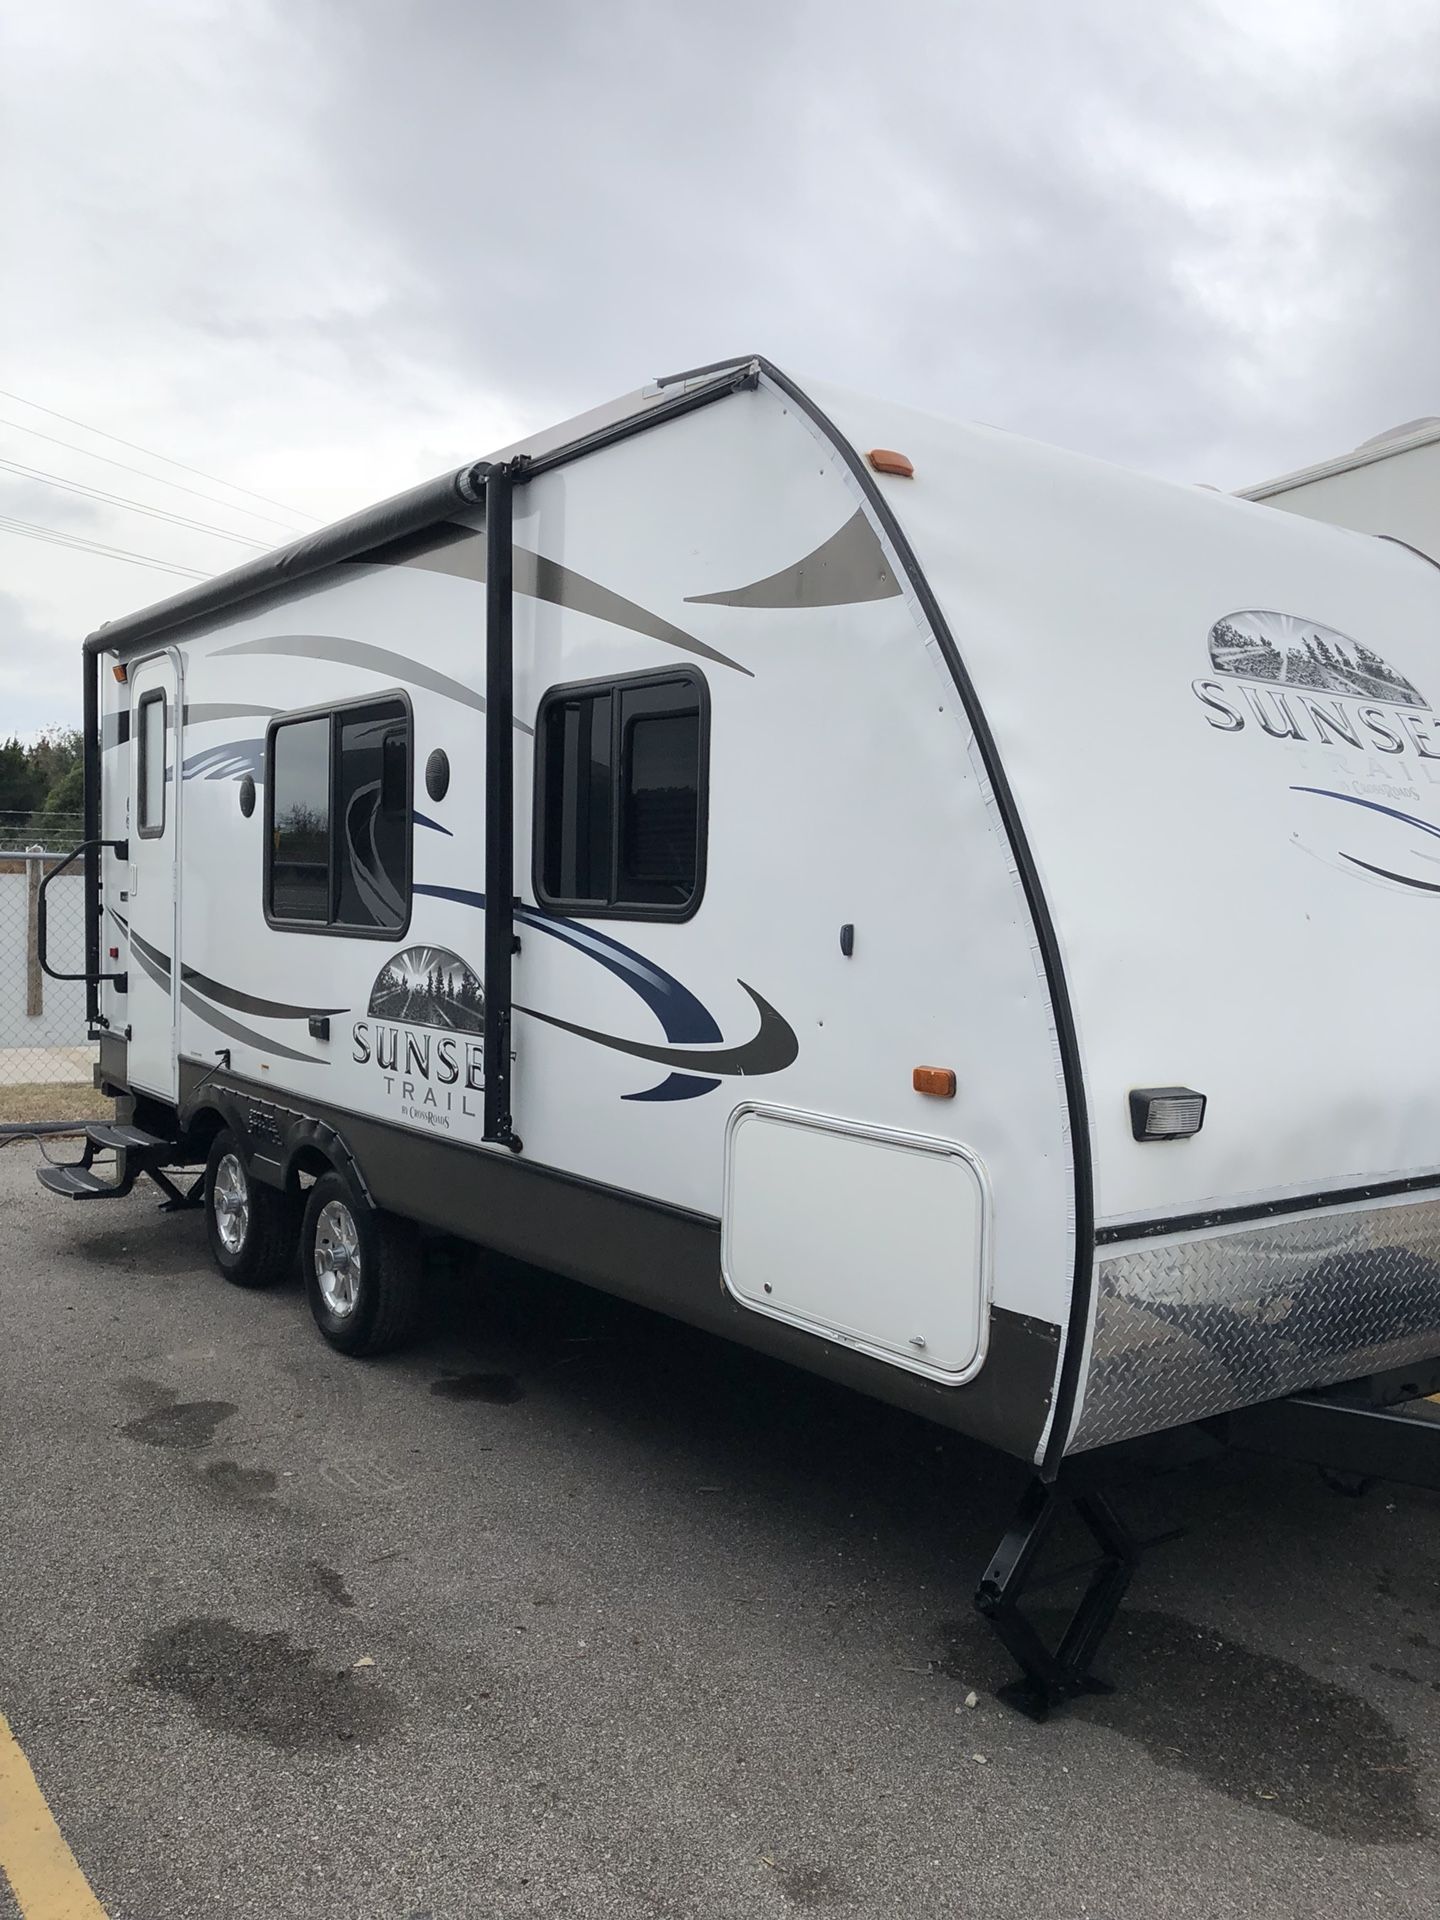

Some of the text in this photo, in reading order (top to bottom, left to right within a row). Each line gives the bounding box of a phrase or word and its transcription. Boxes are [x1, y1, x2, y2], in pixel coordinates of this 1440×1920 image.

[1191, 678, 1440, 760] SUNSE
[352, 1021, 517, 1093] SUNSE
[383, 1076, 476, 1117] TRAIL
